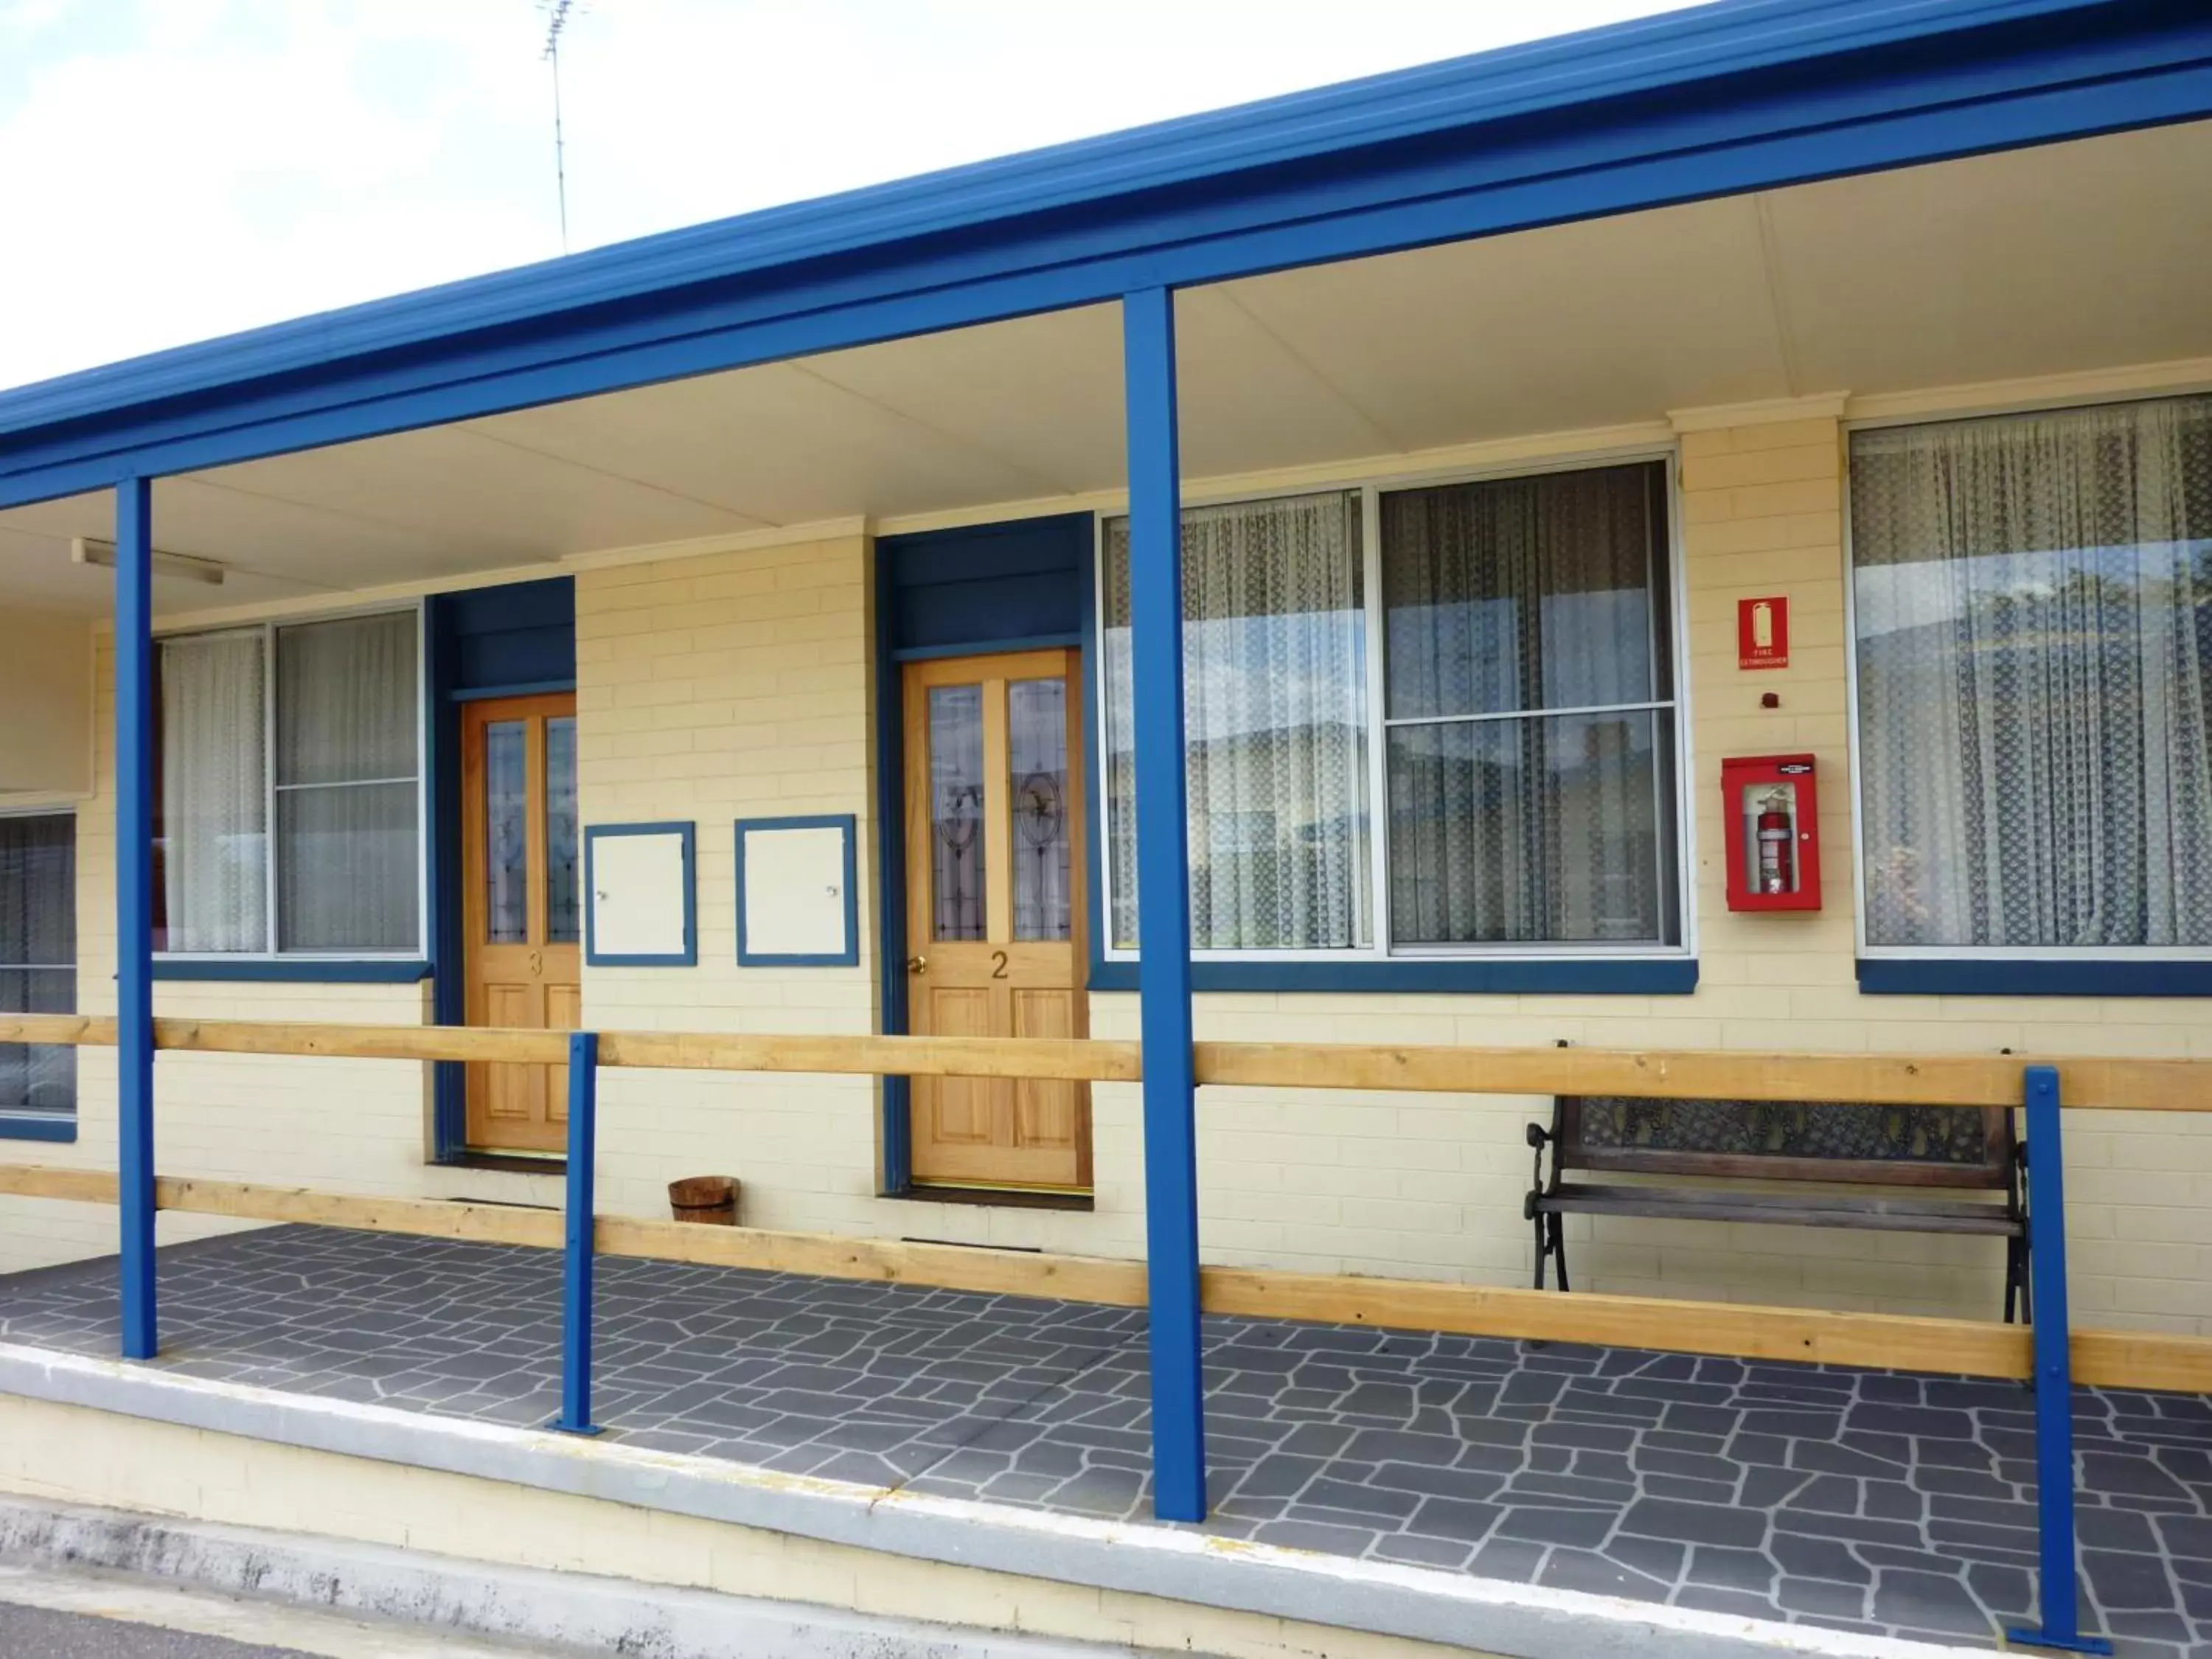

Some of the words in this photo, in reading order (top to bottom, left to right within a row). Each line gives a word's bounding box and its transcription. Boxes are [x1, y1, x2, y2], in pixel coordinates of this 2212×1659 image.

[1753, 648, 1773, 657] FIRE
[529, 950, 543, 978] 3
[991, 950, 1009, 979] 2
